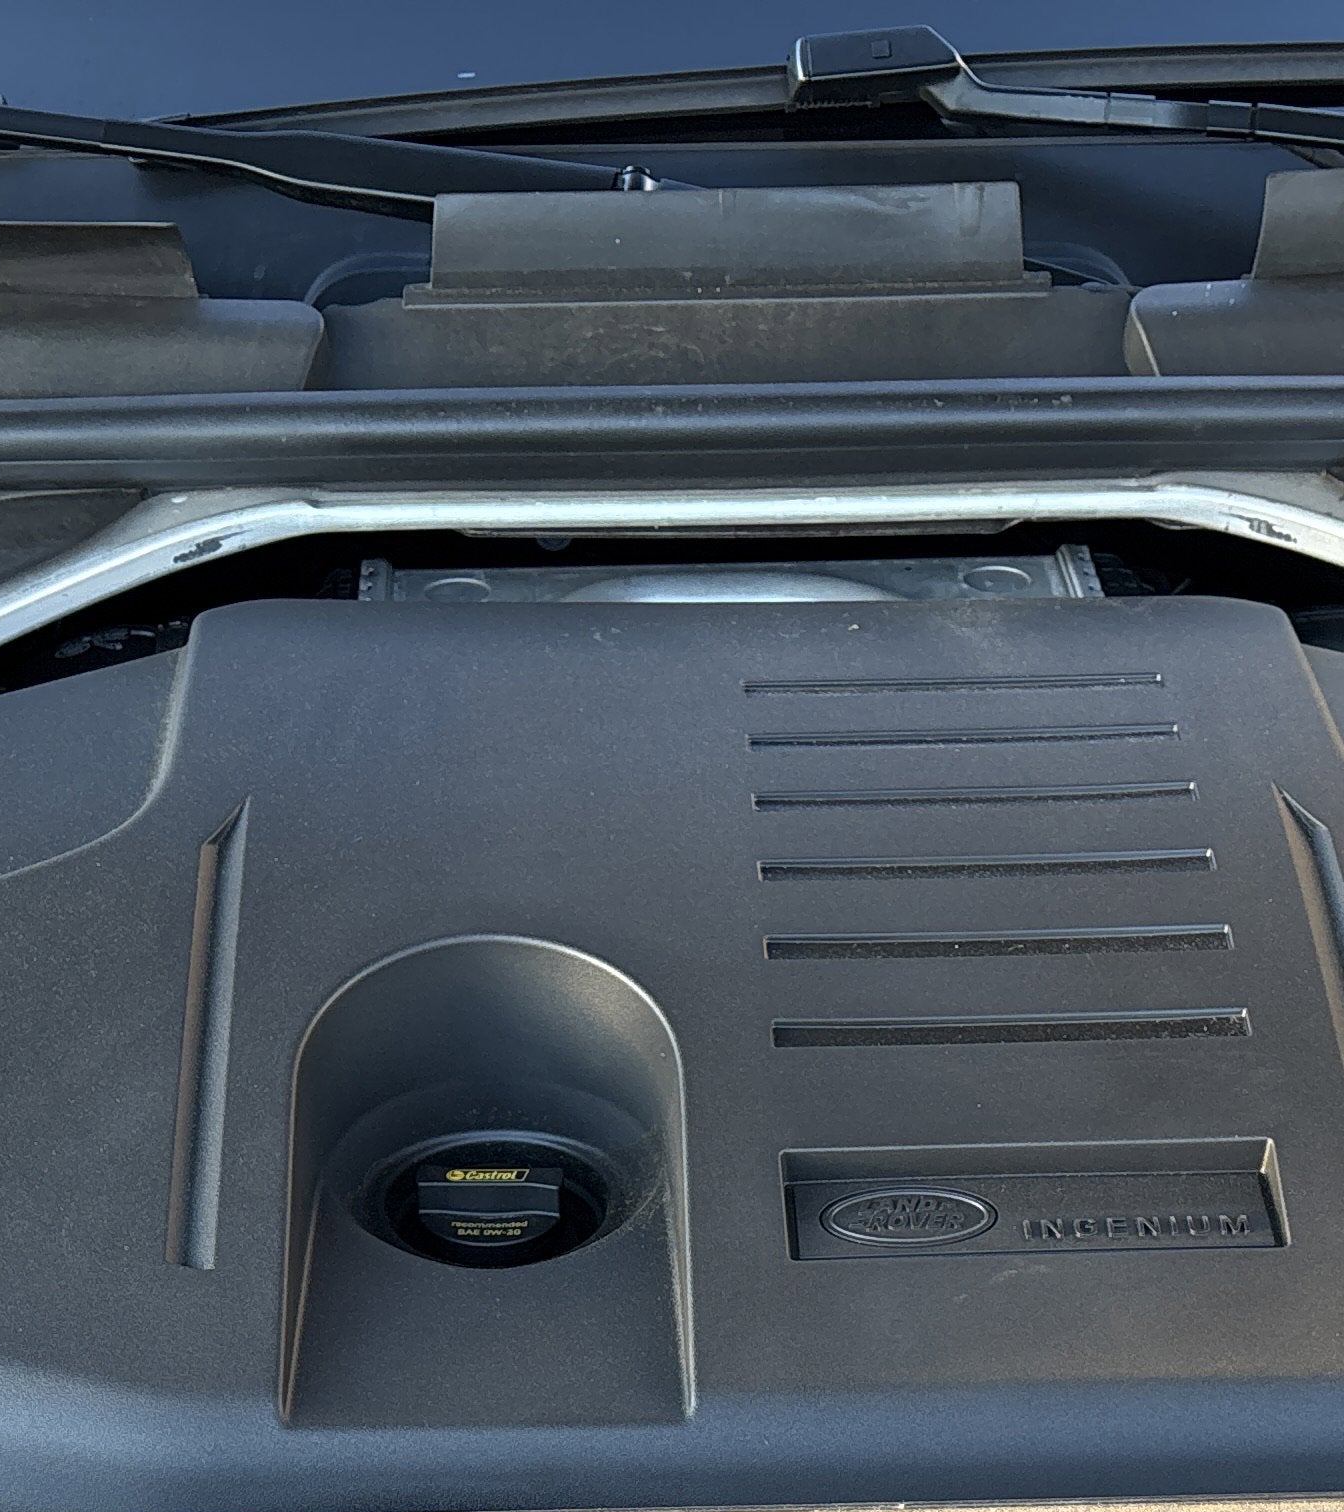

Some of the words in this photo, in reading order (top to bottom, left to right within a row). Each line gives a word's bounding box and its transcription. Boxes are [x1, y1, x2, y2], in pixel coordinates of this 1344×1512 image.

[465, 1170, 517, 1181] Castrol
[857, 1197, 941, 1214] LAND
[451, 1220, 528, 1228] recommended
[864, 1211, 965, 1233] ROVER
[1022, 1214, 1251, 1240] INGENIUM
[457, 1228, 480, 1236] SAE
[483, 1228, 522, 1236] 0W-20
